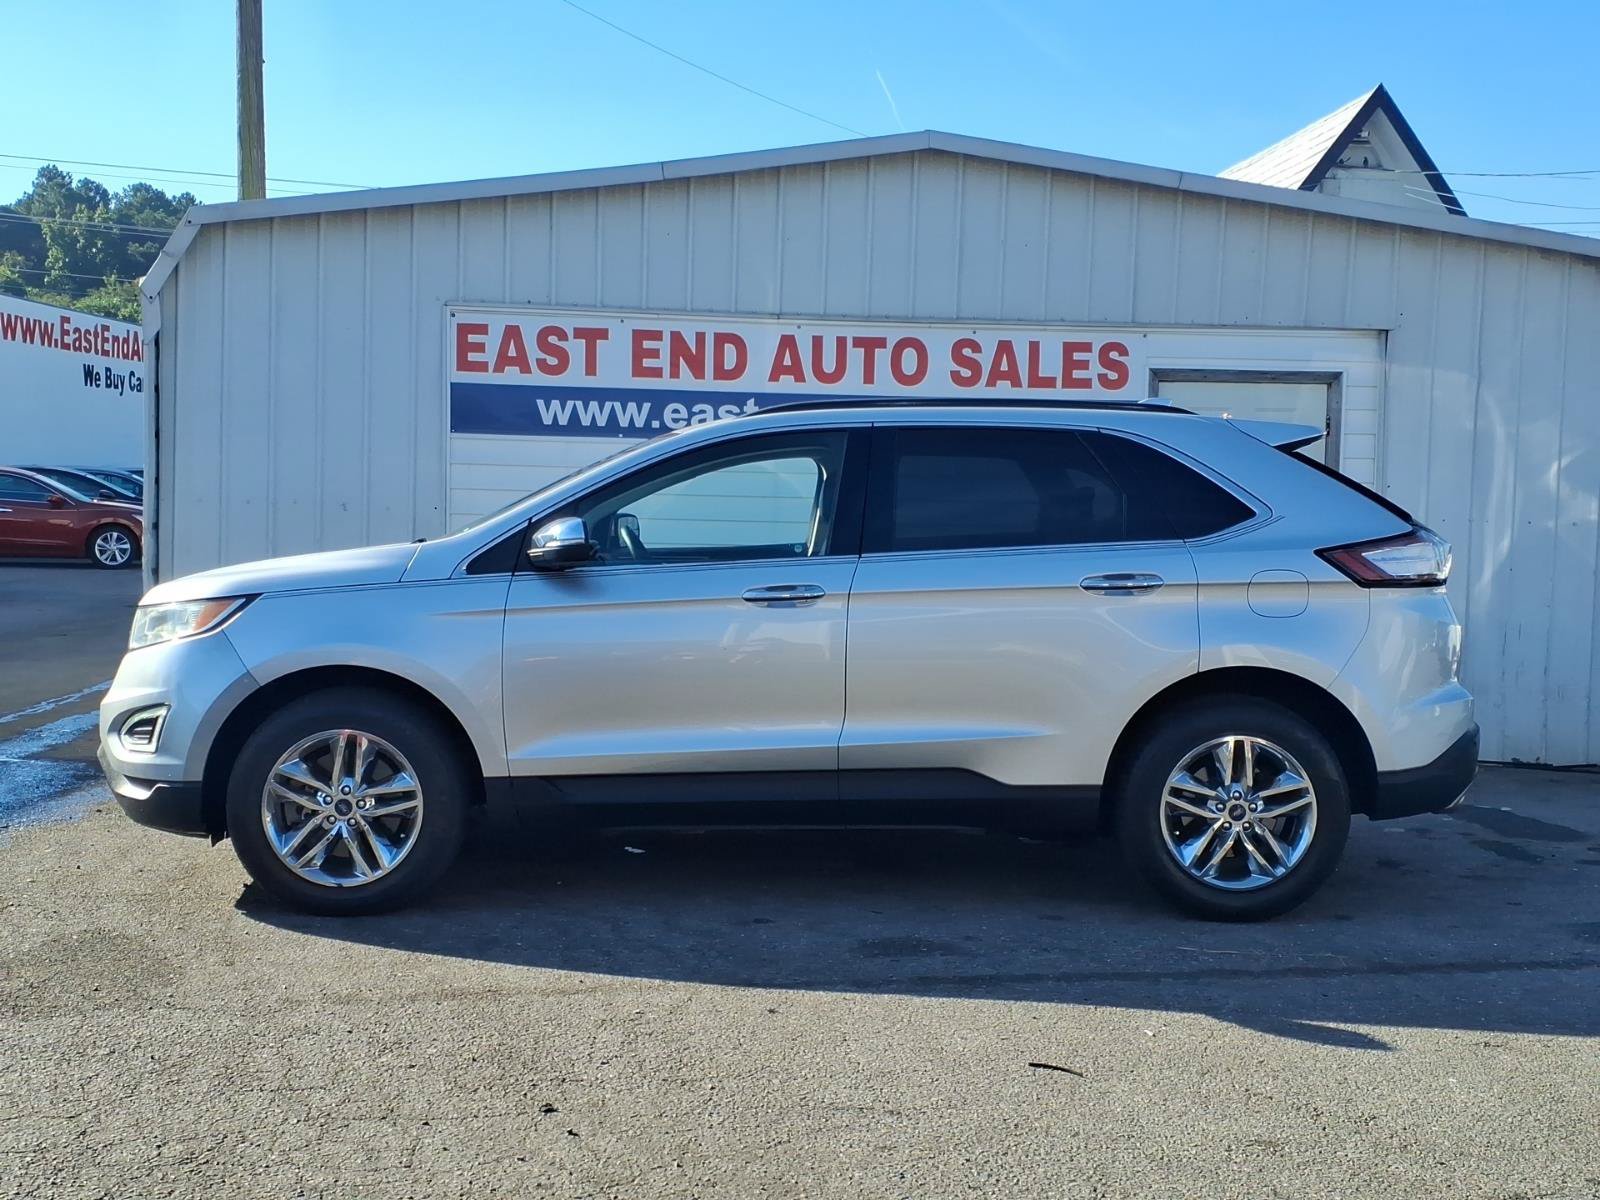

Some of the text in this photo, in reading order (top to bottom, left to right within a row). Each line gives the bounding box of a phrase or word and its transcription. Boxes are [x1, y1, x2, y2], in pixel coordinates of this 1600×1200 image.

[0, 312, 144, 362] www.EastEndA
[456, 323, 1130, 391] EAST END AUTO SALES
[83, 363, 144, 397] We Buy Ca
